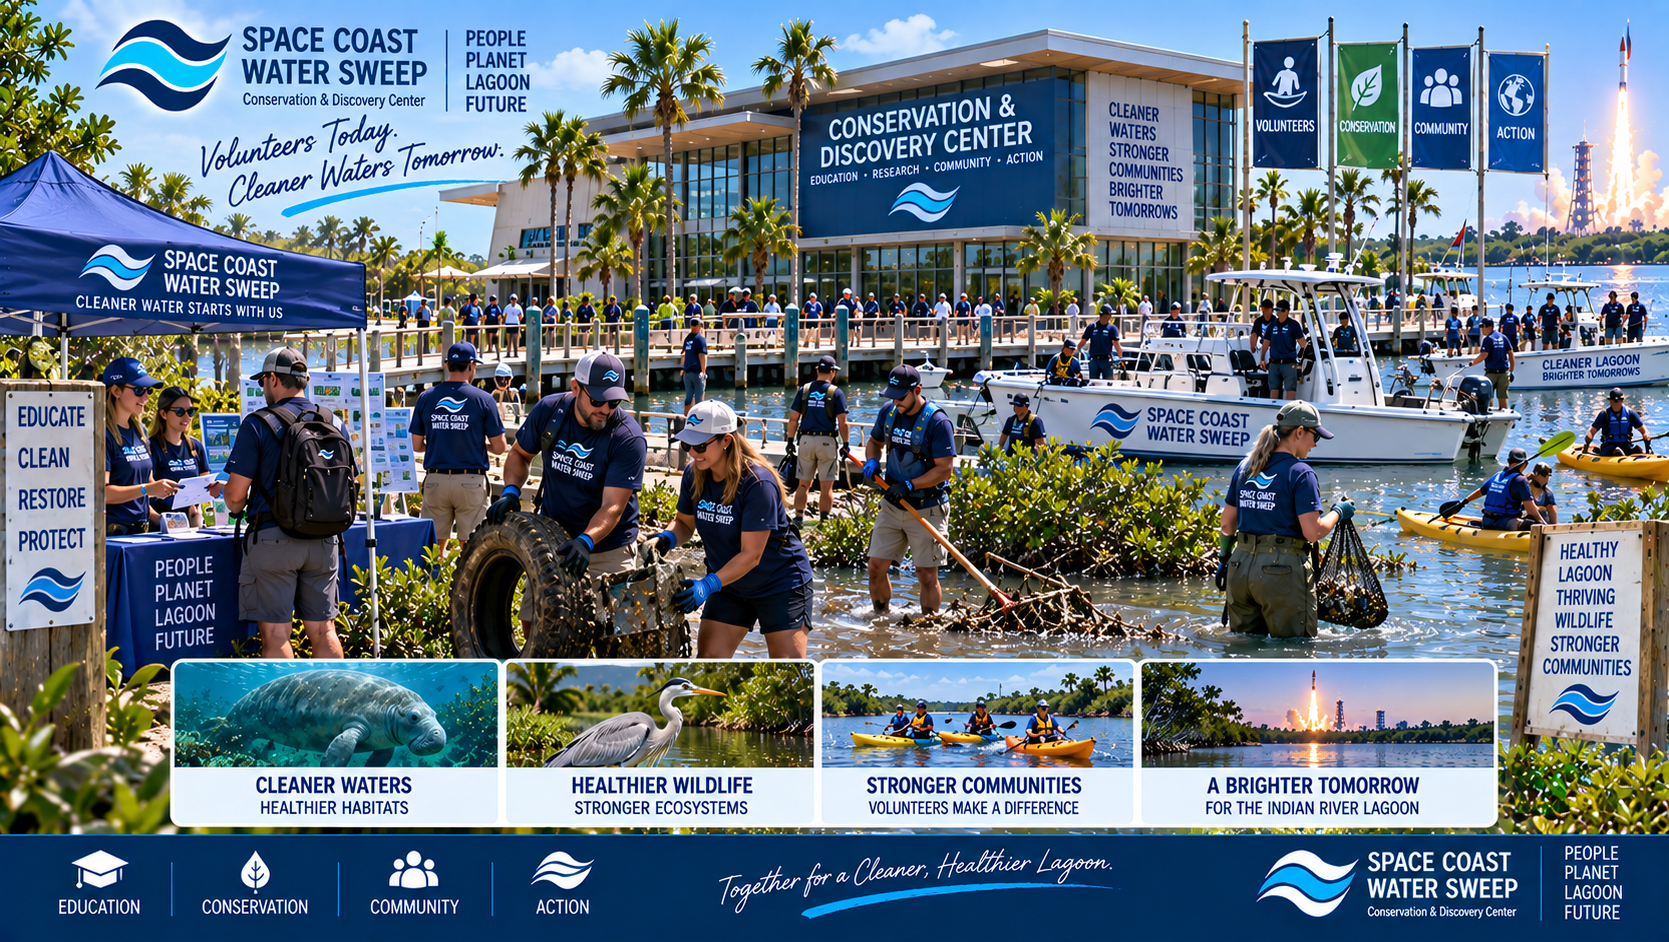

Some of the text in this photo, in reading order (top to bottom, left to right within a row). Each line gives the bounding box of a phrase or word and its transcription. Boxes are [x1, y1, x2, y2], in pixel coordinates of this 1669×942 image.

[829, 94, 1015, 141] CONSERVATION &
[1109, 102, 1159, 122] CLEANER
[1110, 122, 1156, 141] WATERS
[1256, 120, 1314, 132] VOLUNTEERS
[1340, 120, 1395, 133] CONSERVATION
[1415, 122, 1468, 134] COMMUNITY
[1497, 126, 1534, 139] ACTION
[820, 121, 1032, 169] DISCOVERY CENTER
[1110, 142, 1169, 162] STRONGER
[811, 151, 1042, 185] EDUCATION RESEARCH COMMUNITY ACTION
[1110, 162, 1183, 182] COMMUNITIES
[1110, 181, 1163, 199] BRIGHTER
[1109, 201, 1177, 219] TOMORROWS
[164, 250, 277, 277] SPACE COAST
[164, 273, 279, 299] WATER SWEEP
[76, 295, 282, 318] CLEANER WATER STARTS WITH US
[1543, 354, 1639, 370] CLEANER LAGOON
[1543, 367, 1640, 381] BRIGHTER TOMORROWS
[19, 406, 85, 427] EDUCATE
[1148, 407, 1249, 428] SPACE COAST
[1147, 426, 1250, 446] WATER SWEEP
[18, 447, 69, 468] CLEAN
[19, 487, 85, 510] RESTORE
[19, 528, 85, 551] PROTECT
[1561, 541, 1618, 560] HEALTHY
[156, 556, 212, 578] PEOPLE
[1559, 565, 1612, 582] LAGOON
[156, 580, 213, 602] PLANET
[1556, 588, 1615, 605] THRIVING
[156, 603, 215, 626] LAGOON
[1555, 612, 1613, 628] WILDLIFE
[156, 627, 214, 650] FUTURE
[1551, 636, 1619, 652] STRONGER
[1543, 658, 1631, 676] COMMUNITIES
